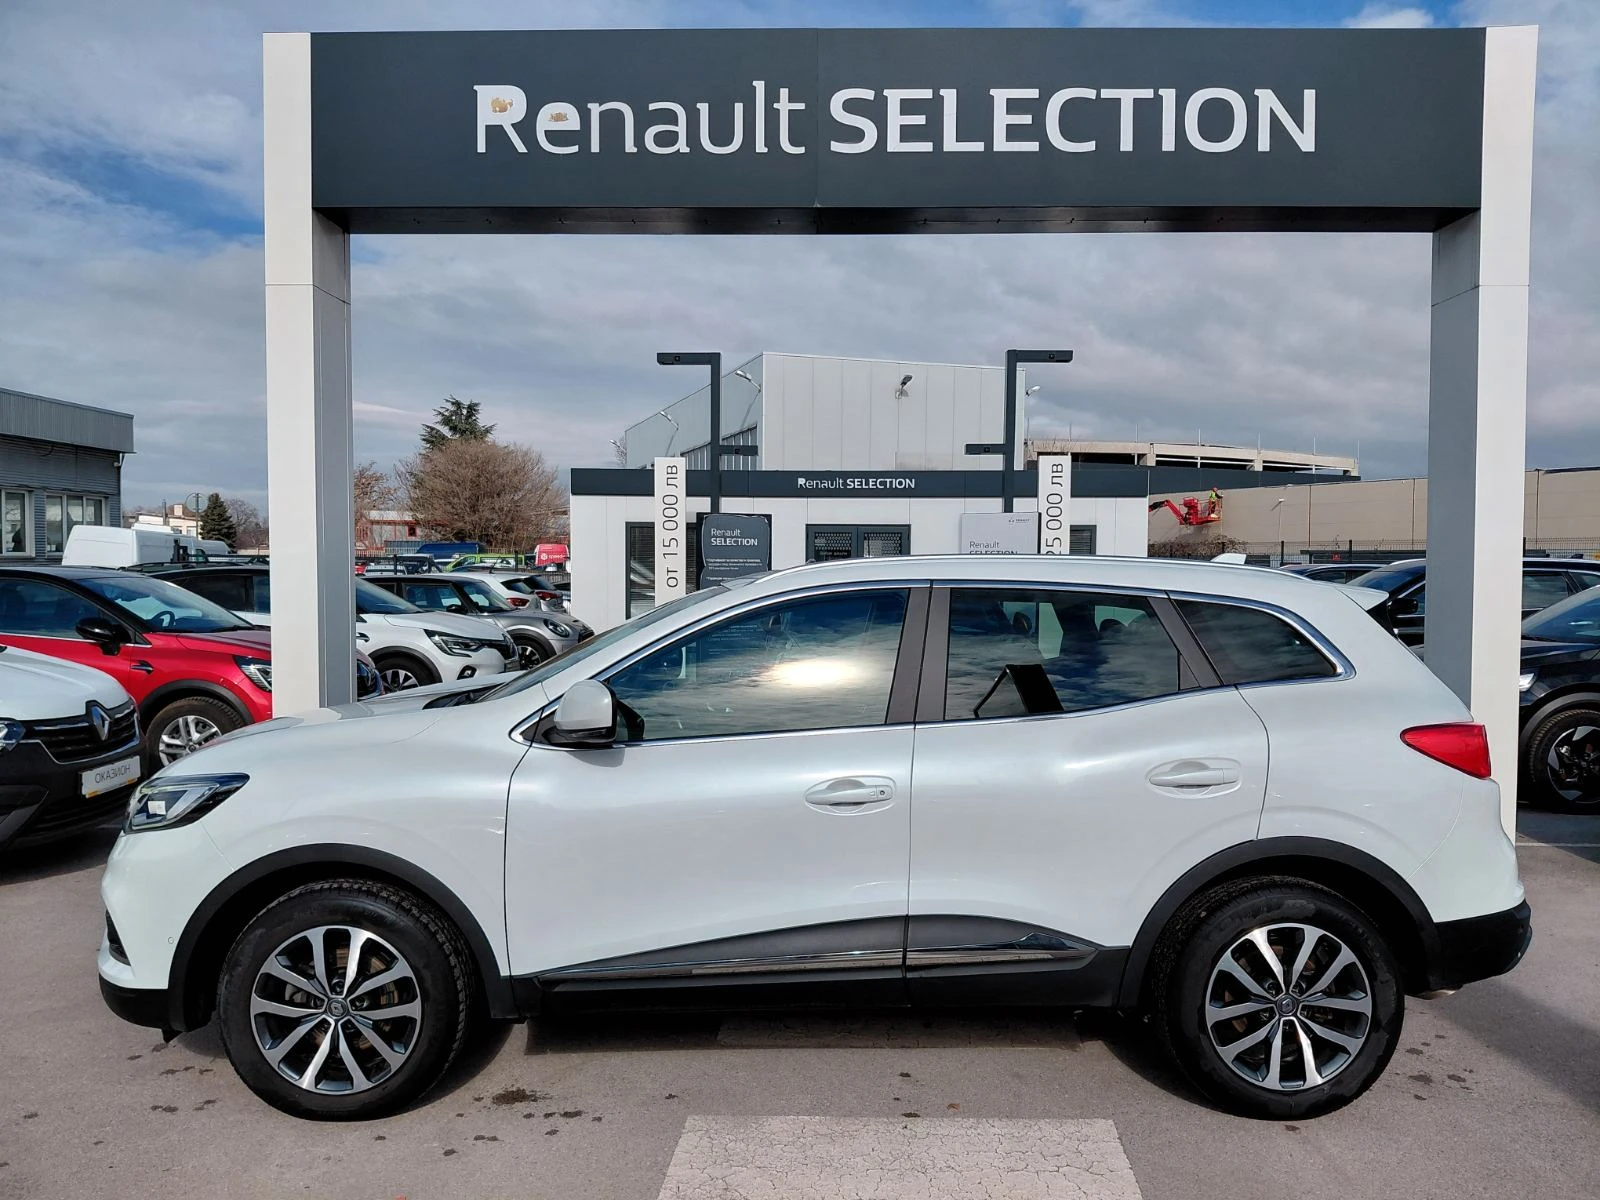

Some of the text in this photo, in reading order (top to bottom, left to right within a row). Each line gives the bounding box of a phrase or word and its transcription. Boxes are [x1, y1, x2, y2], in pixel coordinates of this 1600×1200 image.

[474, 80, 1317, 154] Renault SELECTION
[797, 477, 915, 489] Renault SELECTION
[662, 494, 679, 532] 000
[1045, 493, 1063, 531] 000
[711, 528, 741, 537] Renault
[711, 537, 758, 546] SELECTION
[662, 537, 679, 560] 15
[969, 540, 1000, 549] Renault
[95, 764, 130, 784] ОКАЗИОН
